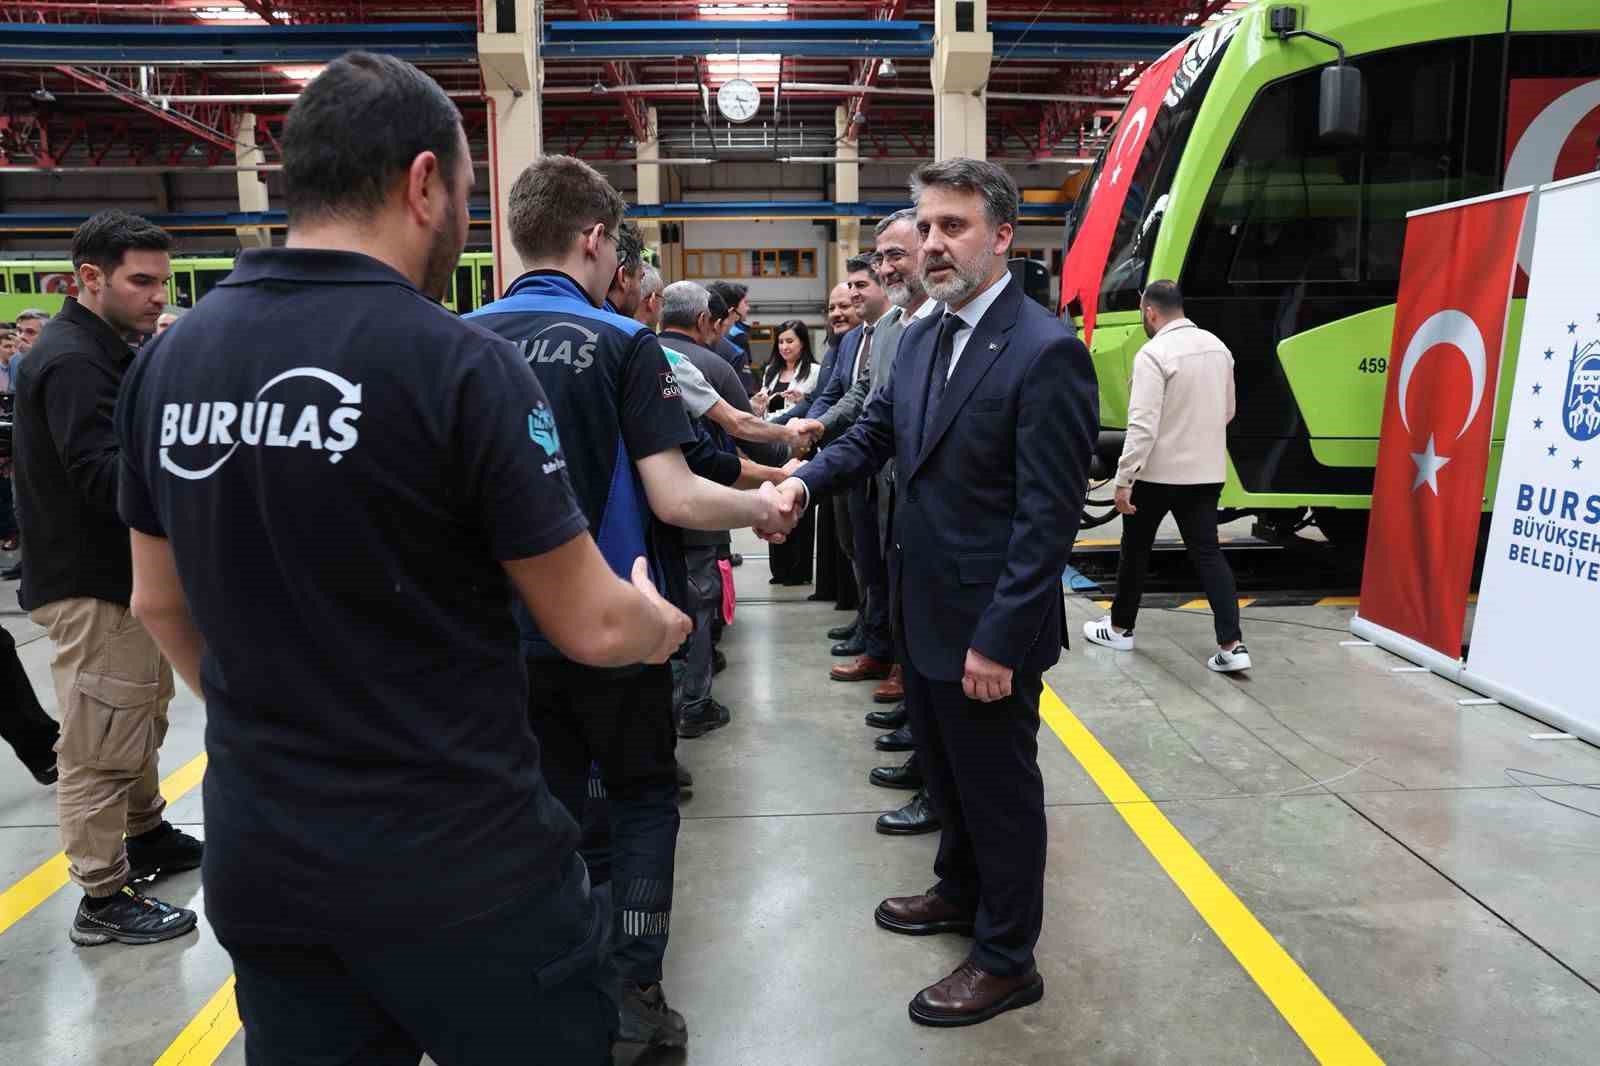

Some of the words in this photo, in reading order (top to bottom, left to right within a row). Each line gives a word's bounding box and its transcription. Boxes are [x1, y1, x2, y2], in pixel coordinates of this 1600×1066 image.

[511, 339, 597, 374] ULAŞ
[1358, 358, 1390, 373] 459
[160, 401, 362, 464] BURULAŞ
[1517, 483, 1600, 525] BURS
[1509, 543, 1600, 582] BELEDİYE
